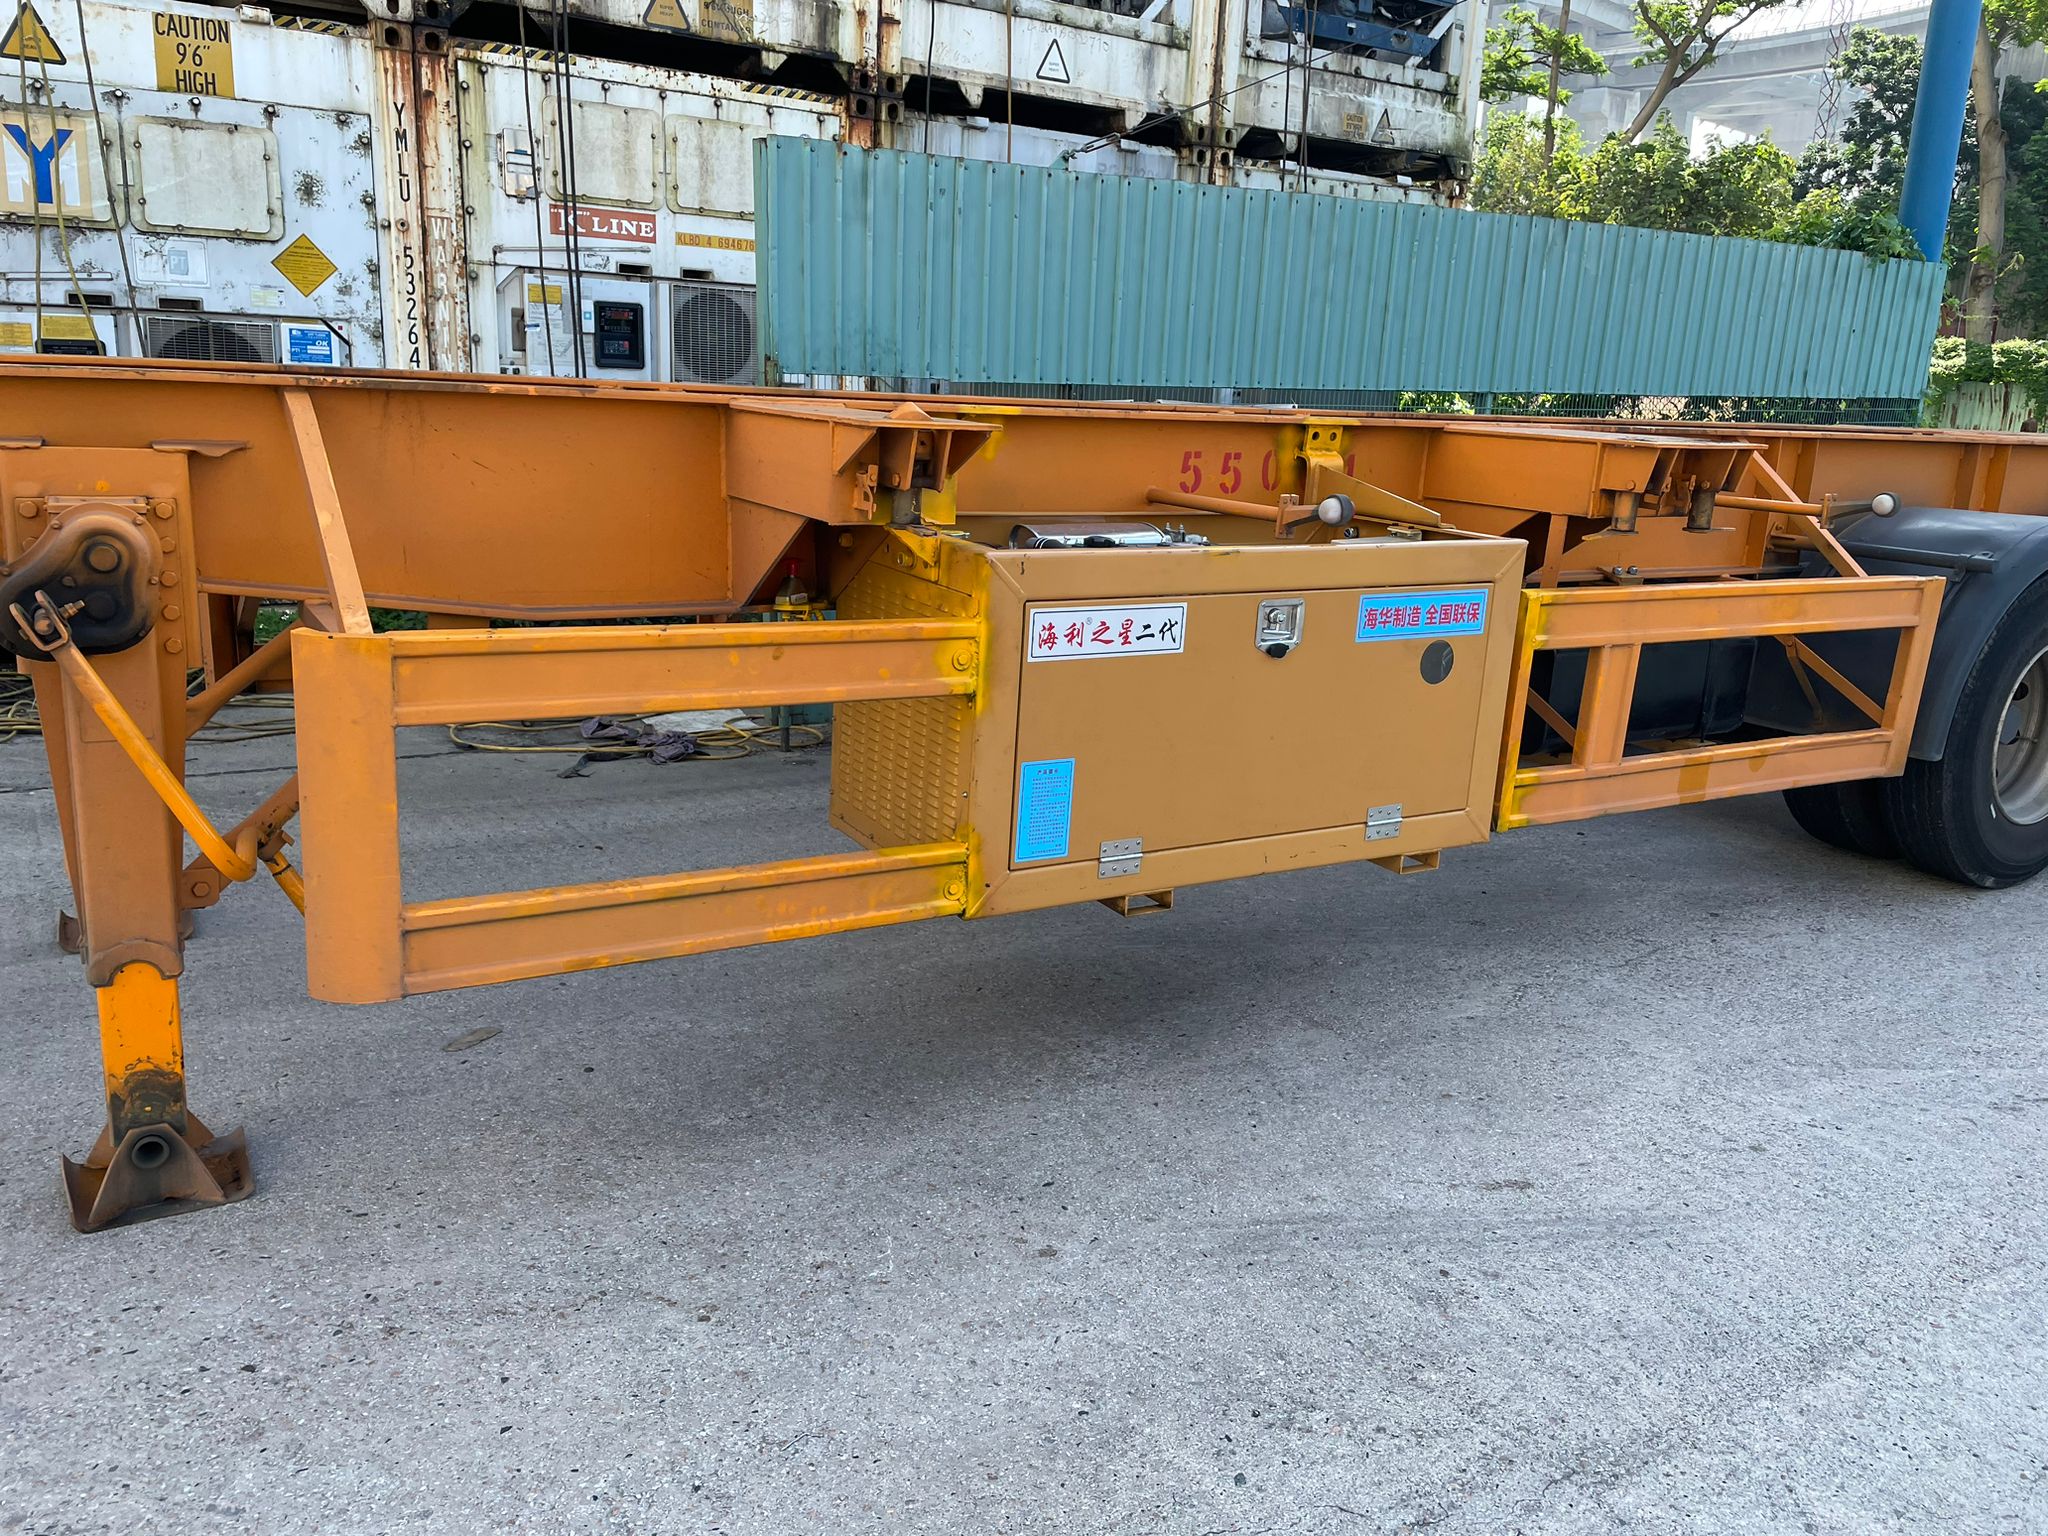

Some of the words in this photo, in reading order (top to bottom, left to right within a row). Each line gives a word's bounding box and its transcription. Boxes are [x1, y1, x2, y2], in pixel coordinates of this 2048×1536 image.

[155, 12, 229, 43] CAUTION
[176, 42, 210, 67] 9'6"
[175, 68, 216, 95] HIGH
[393, 101, 411, 202] YMLU
[403, 246, 420, 369] 53264
[592, 216, 655, 238] LINE
[706, 236, 712, 246] 4
[718, 237, 755, 252] 694676
[1363, 605, 1422, 631] 海华制造
[1424, 601, 1482, 627] 全国联保
